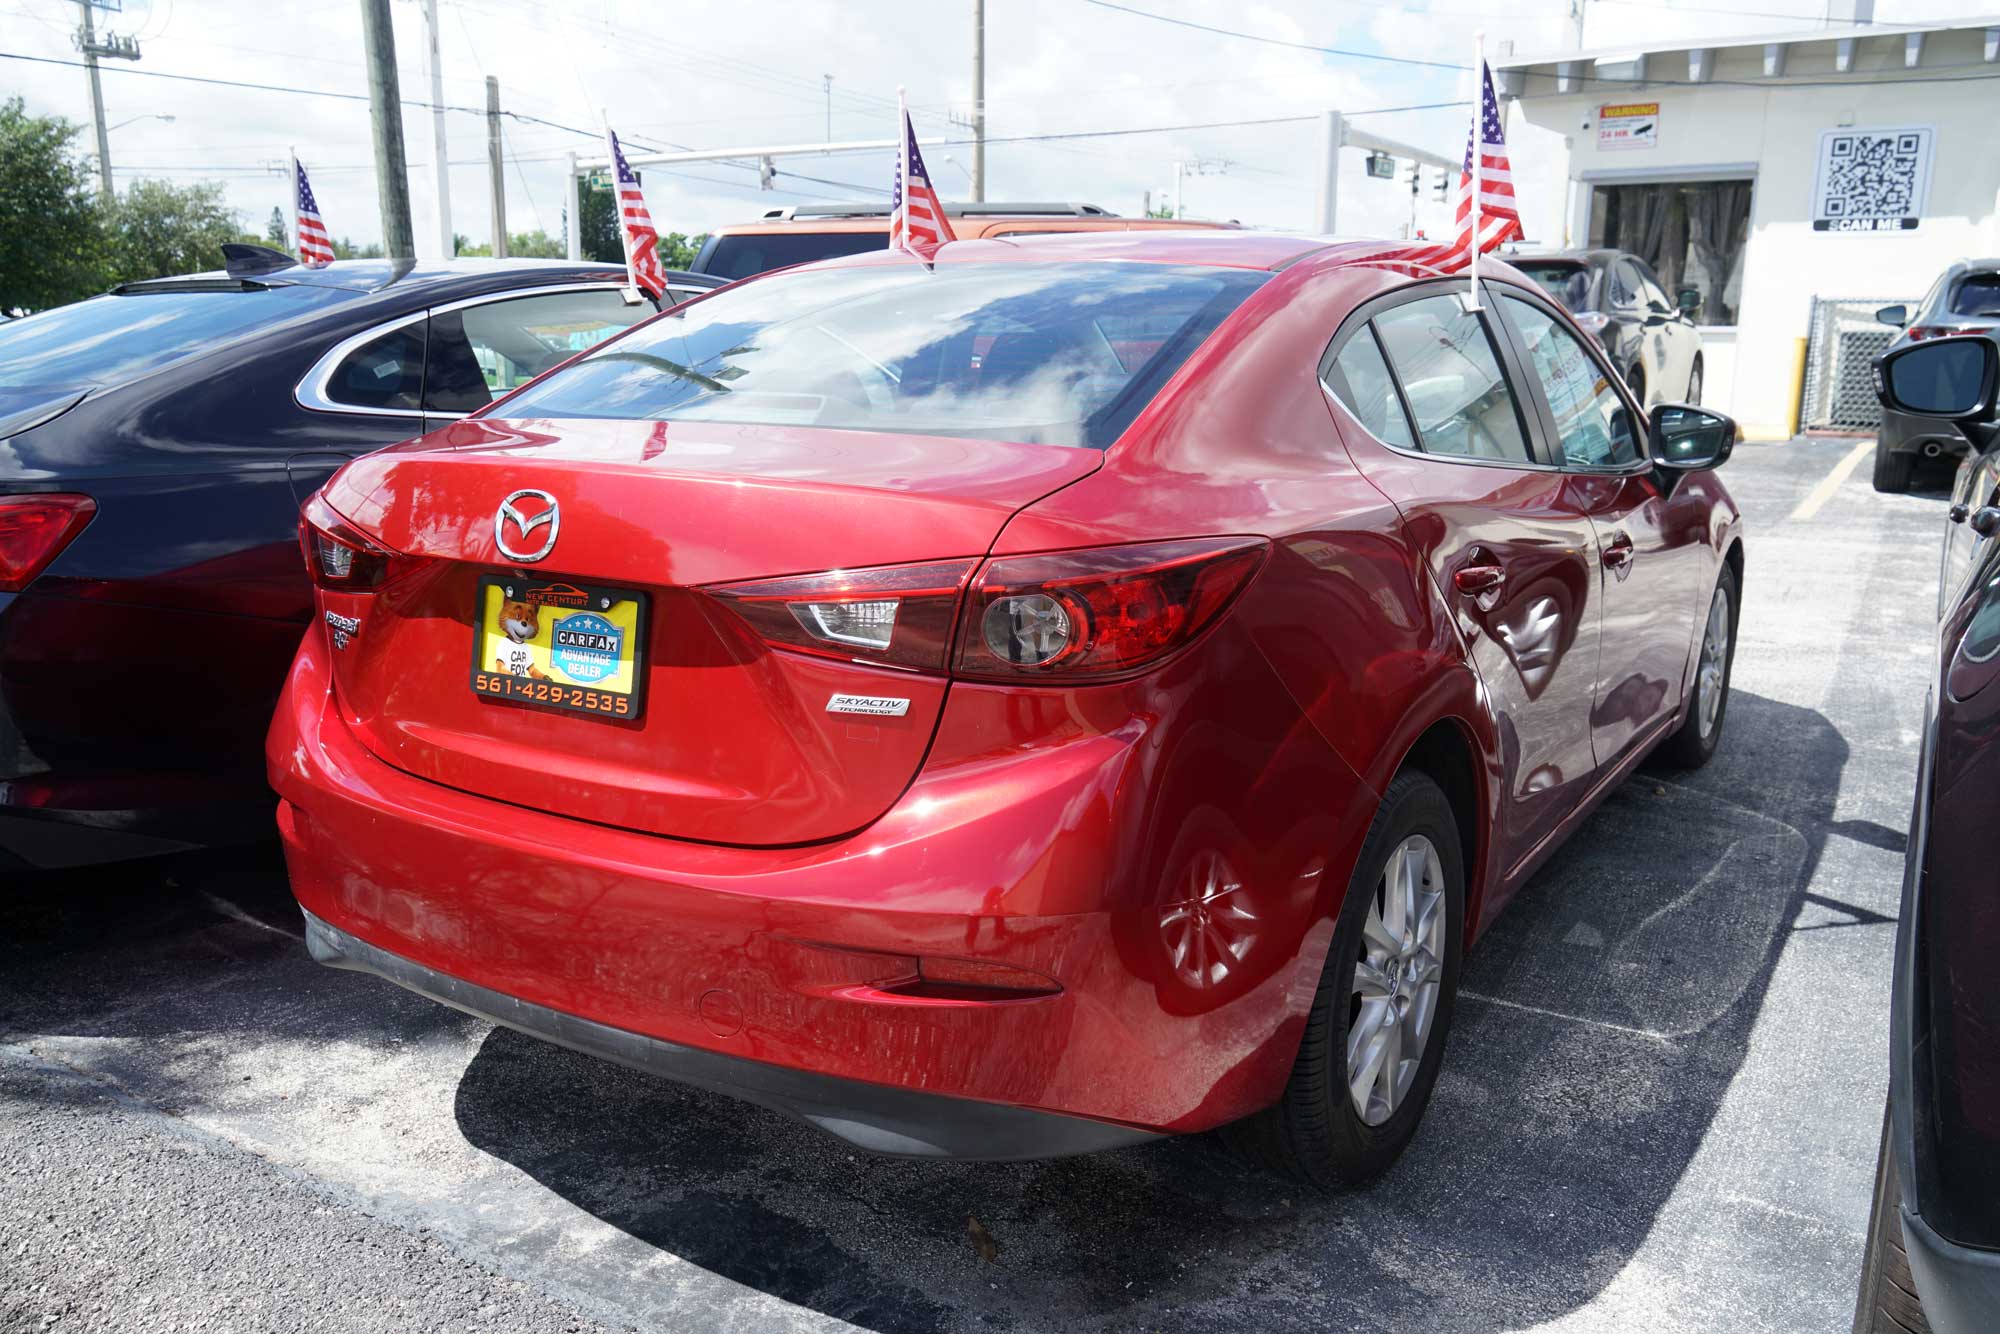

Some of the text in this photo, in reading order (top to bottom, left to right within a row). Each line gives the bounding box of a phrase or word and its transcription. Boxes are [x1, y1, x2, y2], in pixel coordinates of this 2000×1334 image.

[1604, 105, 1657, 117] WARNING
[1828, 218, 1902, 231] SCAN ME
[526, 592, 588, 607] NEW CENTURY
[558, 631, 616, 651] CARFAX
[511, 651, 526, 662] CAR
[560, 649, 611, 666] ADVANTAGE
[511, 664, 526, 676] FOX
[568, 663, 601, 677] DEALER
[476, 674, 629, 714] 561-429-2535
[835, 697, 901, 707] SKYACTIV
